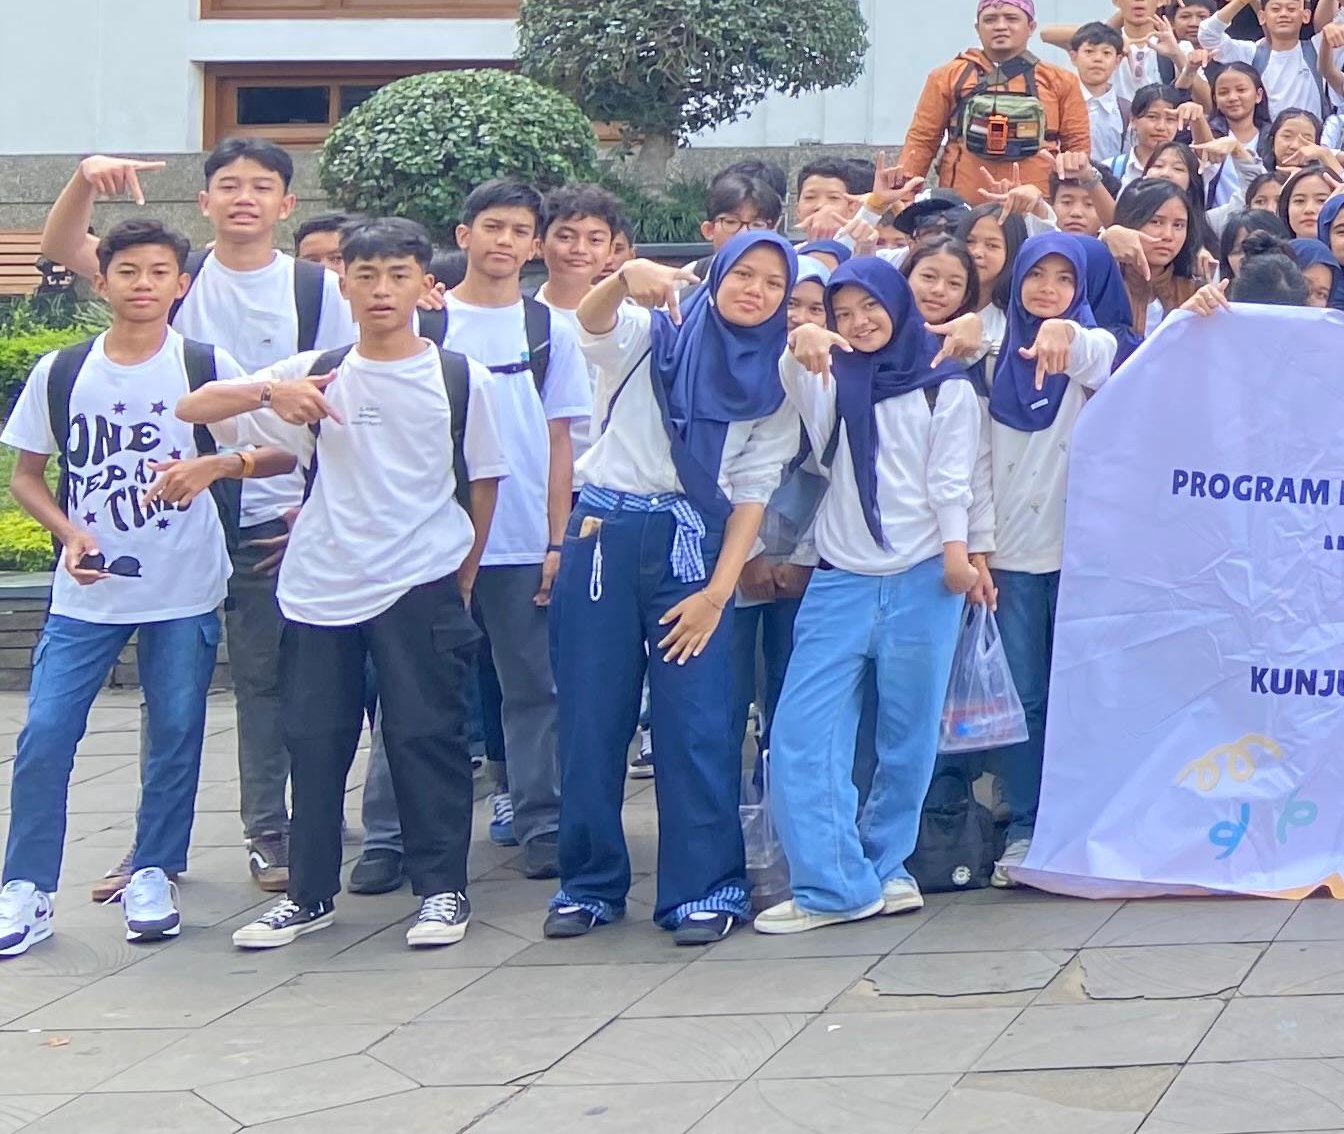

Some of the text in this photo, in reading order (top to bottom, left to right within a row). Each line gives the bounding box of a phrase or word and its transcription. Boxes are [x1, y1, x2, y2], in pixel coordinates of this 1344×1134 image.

[68, 413, 161, 468] ONE
[68, 465, 127, 510] TEP
[1172, 469, 1330, 506] PROGRAM
